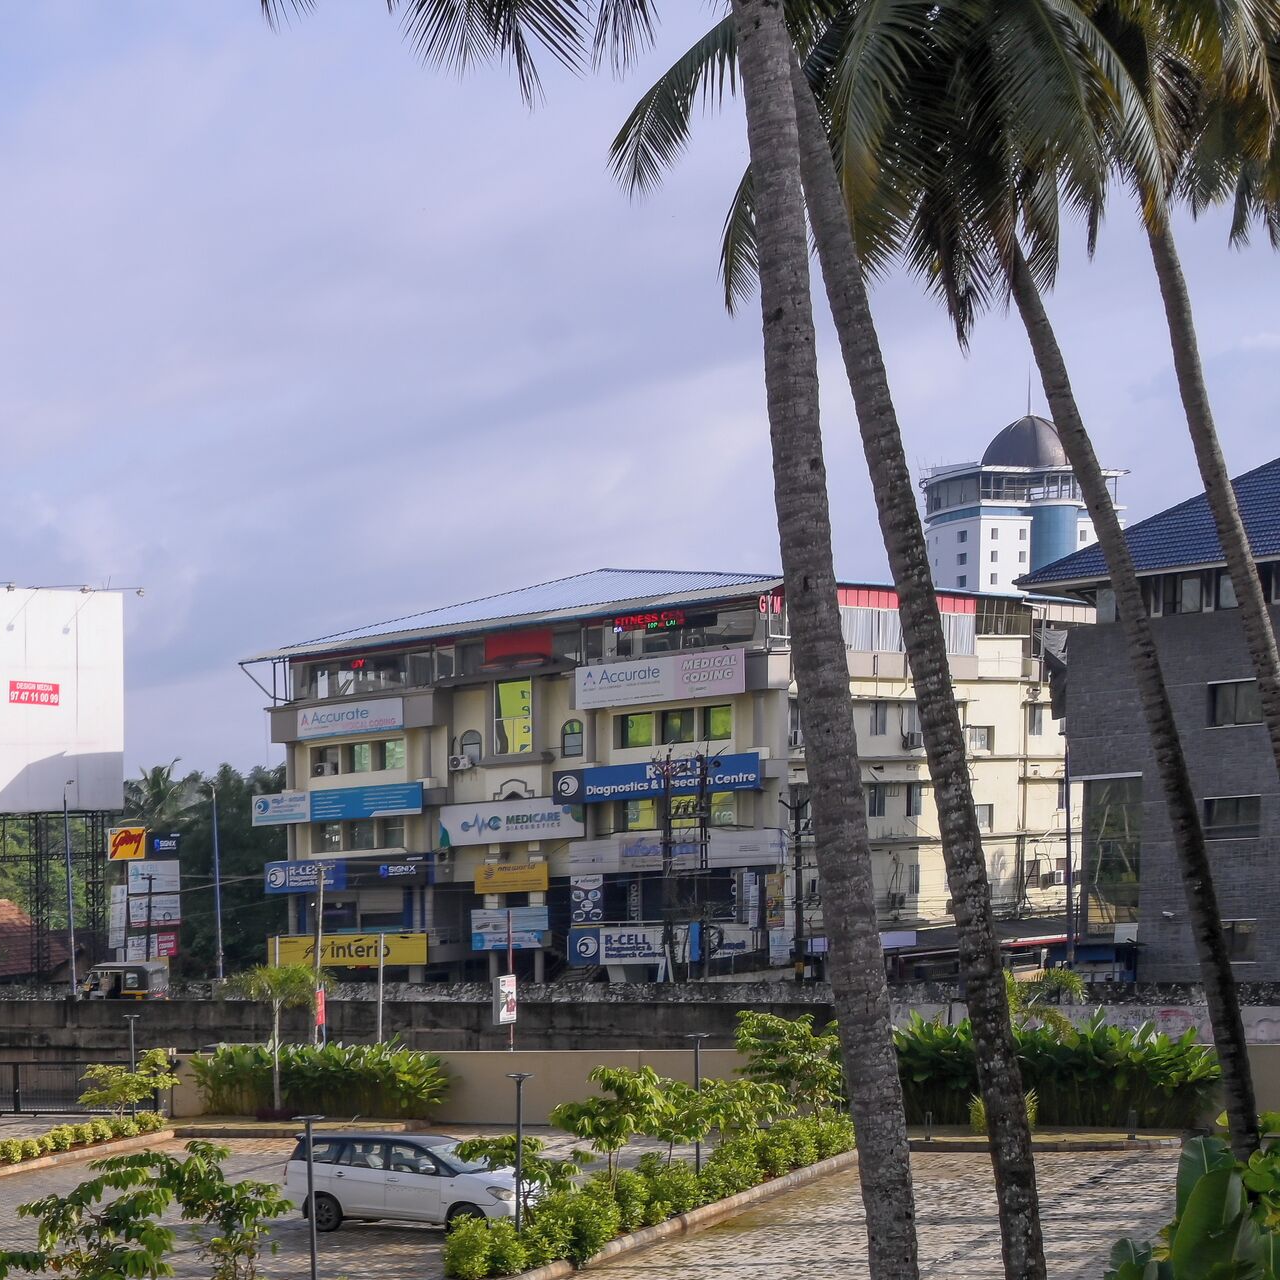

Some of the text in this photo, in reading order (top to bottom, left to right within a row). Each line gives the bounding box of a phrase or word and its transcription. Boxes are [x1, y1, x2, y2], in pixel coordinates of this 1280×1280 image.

[614, 613, 658, 626] FITNESS
[682, 655, 737, 671] MEDICAL
[599, 665, 660, 685] Accurate
[683, 668, 734, 683] CODING
[16, 682, 36, 690] DESIGN
[10, 691, 19, 701] 97
[20, 691, 29, 702] 47
[31, 692, 39, 702] 11
[40, 692, 49, 703] 00
[310, 707, 369, 725] Accurate
[586, 780, 649, 796] Diagnostics
[651, 779, 659, 790] &
[715, 772, 756, 784] Centre
[506, 811, 561, 825] MEDICARE
[506, 822, 561, 832] DIAGNOSTICS
[388, 864, 417, 873] SIGNIX
[604, 933, 650, 946] R-CELL
[331, 940, 391, 958] interio
